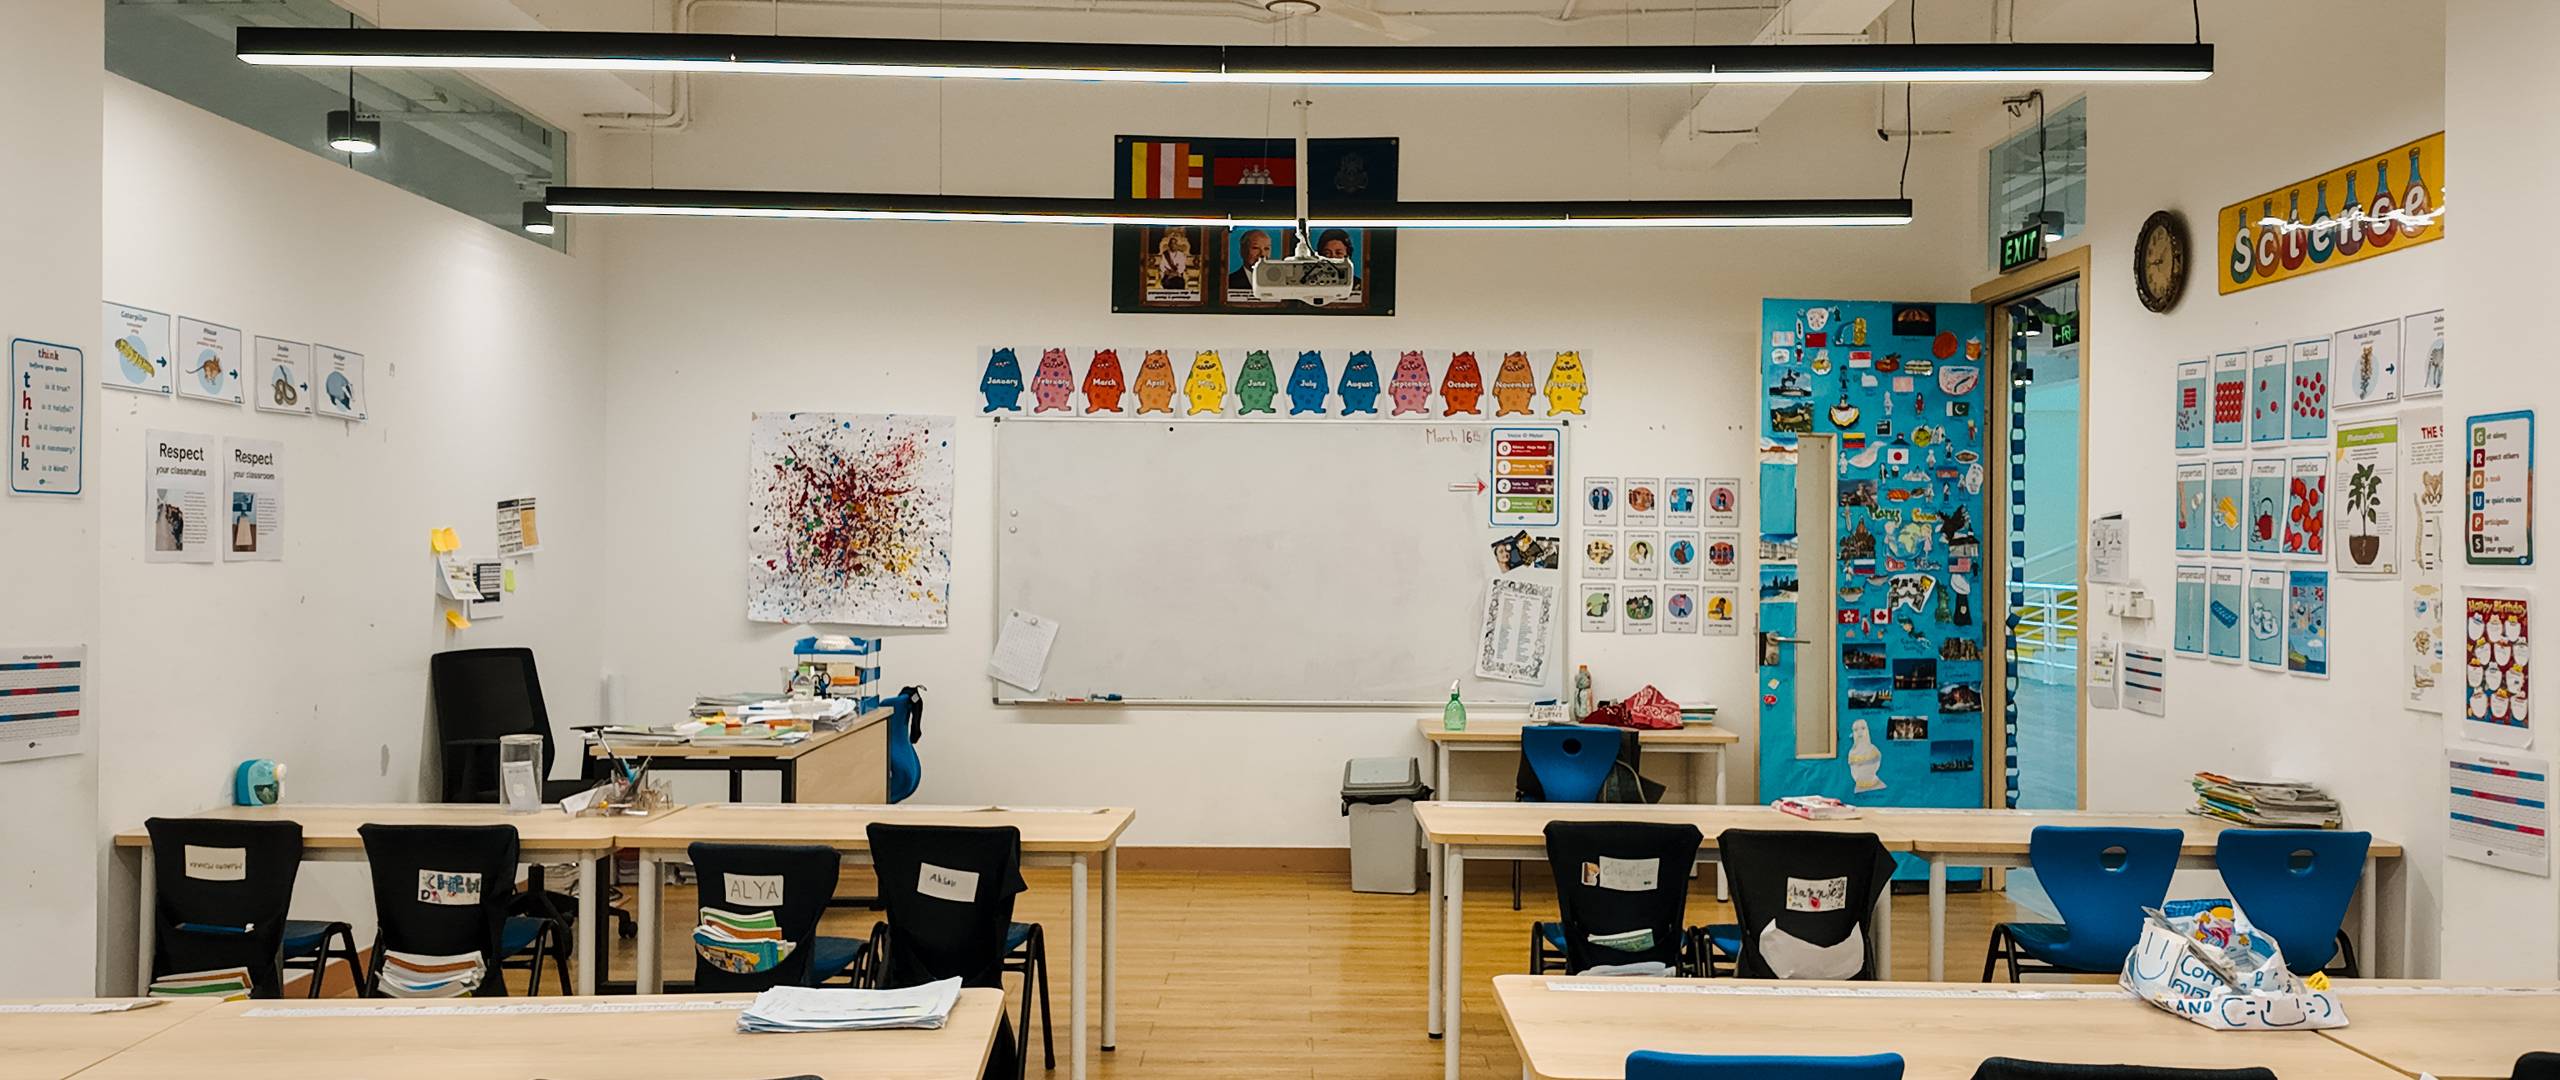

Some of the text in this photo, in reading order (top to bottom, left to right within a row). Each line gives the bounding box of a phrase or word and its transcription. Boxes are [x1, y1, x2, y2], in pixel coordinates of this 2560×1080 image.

[2233, 185, 2424, 273] Science
[2004, 230, 2037, 265] EXIT
[38, 348, 59, 360] think
[987, 377, 1018, 387] January
[1092, 378, 1117, 386] March
[1146, 380, 1166, 388] April
[1300, 380, 1317, 389] July
[1346, 380, 1373, 389] August
[1391, 380, 1430, 389] September
[1426, 428, 1458, 444] March
[2421, 426, 2438, 439] THE
[160, 442, 204, 462] Respect
[235, 449, 273, 467] Respect
[156, 466, 206, 476] your classmates
[233, 471, 275, 480] your classroom
[2468, 600, 2526, 618] Happy Birthday
[730, 880, 780, 900] ALYA
[2176, 999, 2212, 1015] AND
